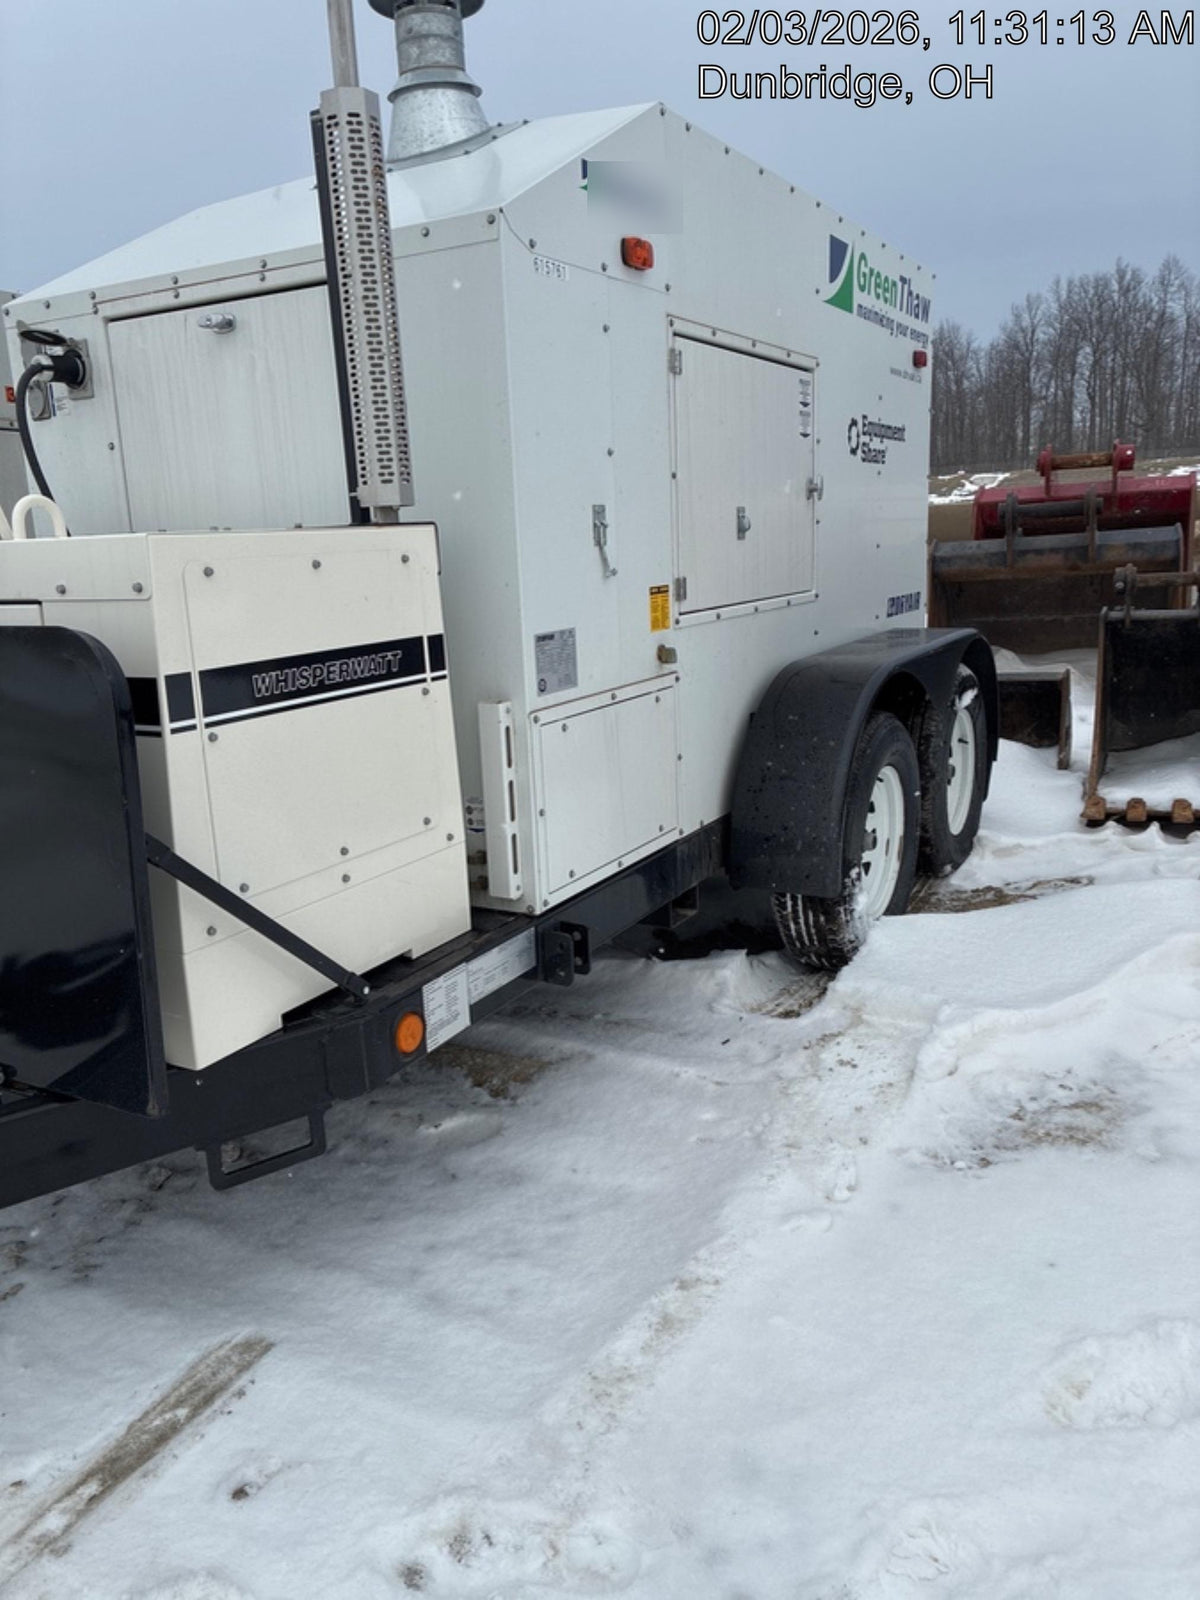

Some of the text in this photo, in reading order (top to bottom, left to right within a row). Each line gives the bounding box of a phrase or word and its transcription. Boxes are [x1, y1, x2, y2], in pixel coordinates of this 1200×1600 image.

[857, 252, 931, 324] GreenThaw
[862, 414, 906, 443] Equipment
[861, 441, 887, 465] Share
[252, 650, 402, 697] WHISPERWATT
